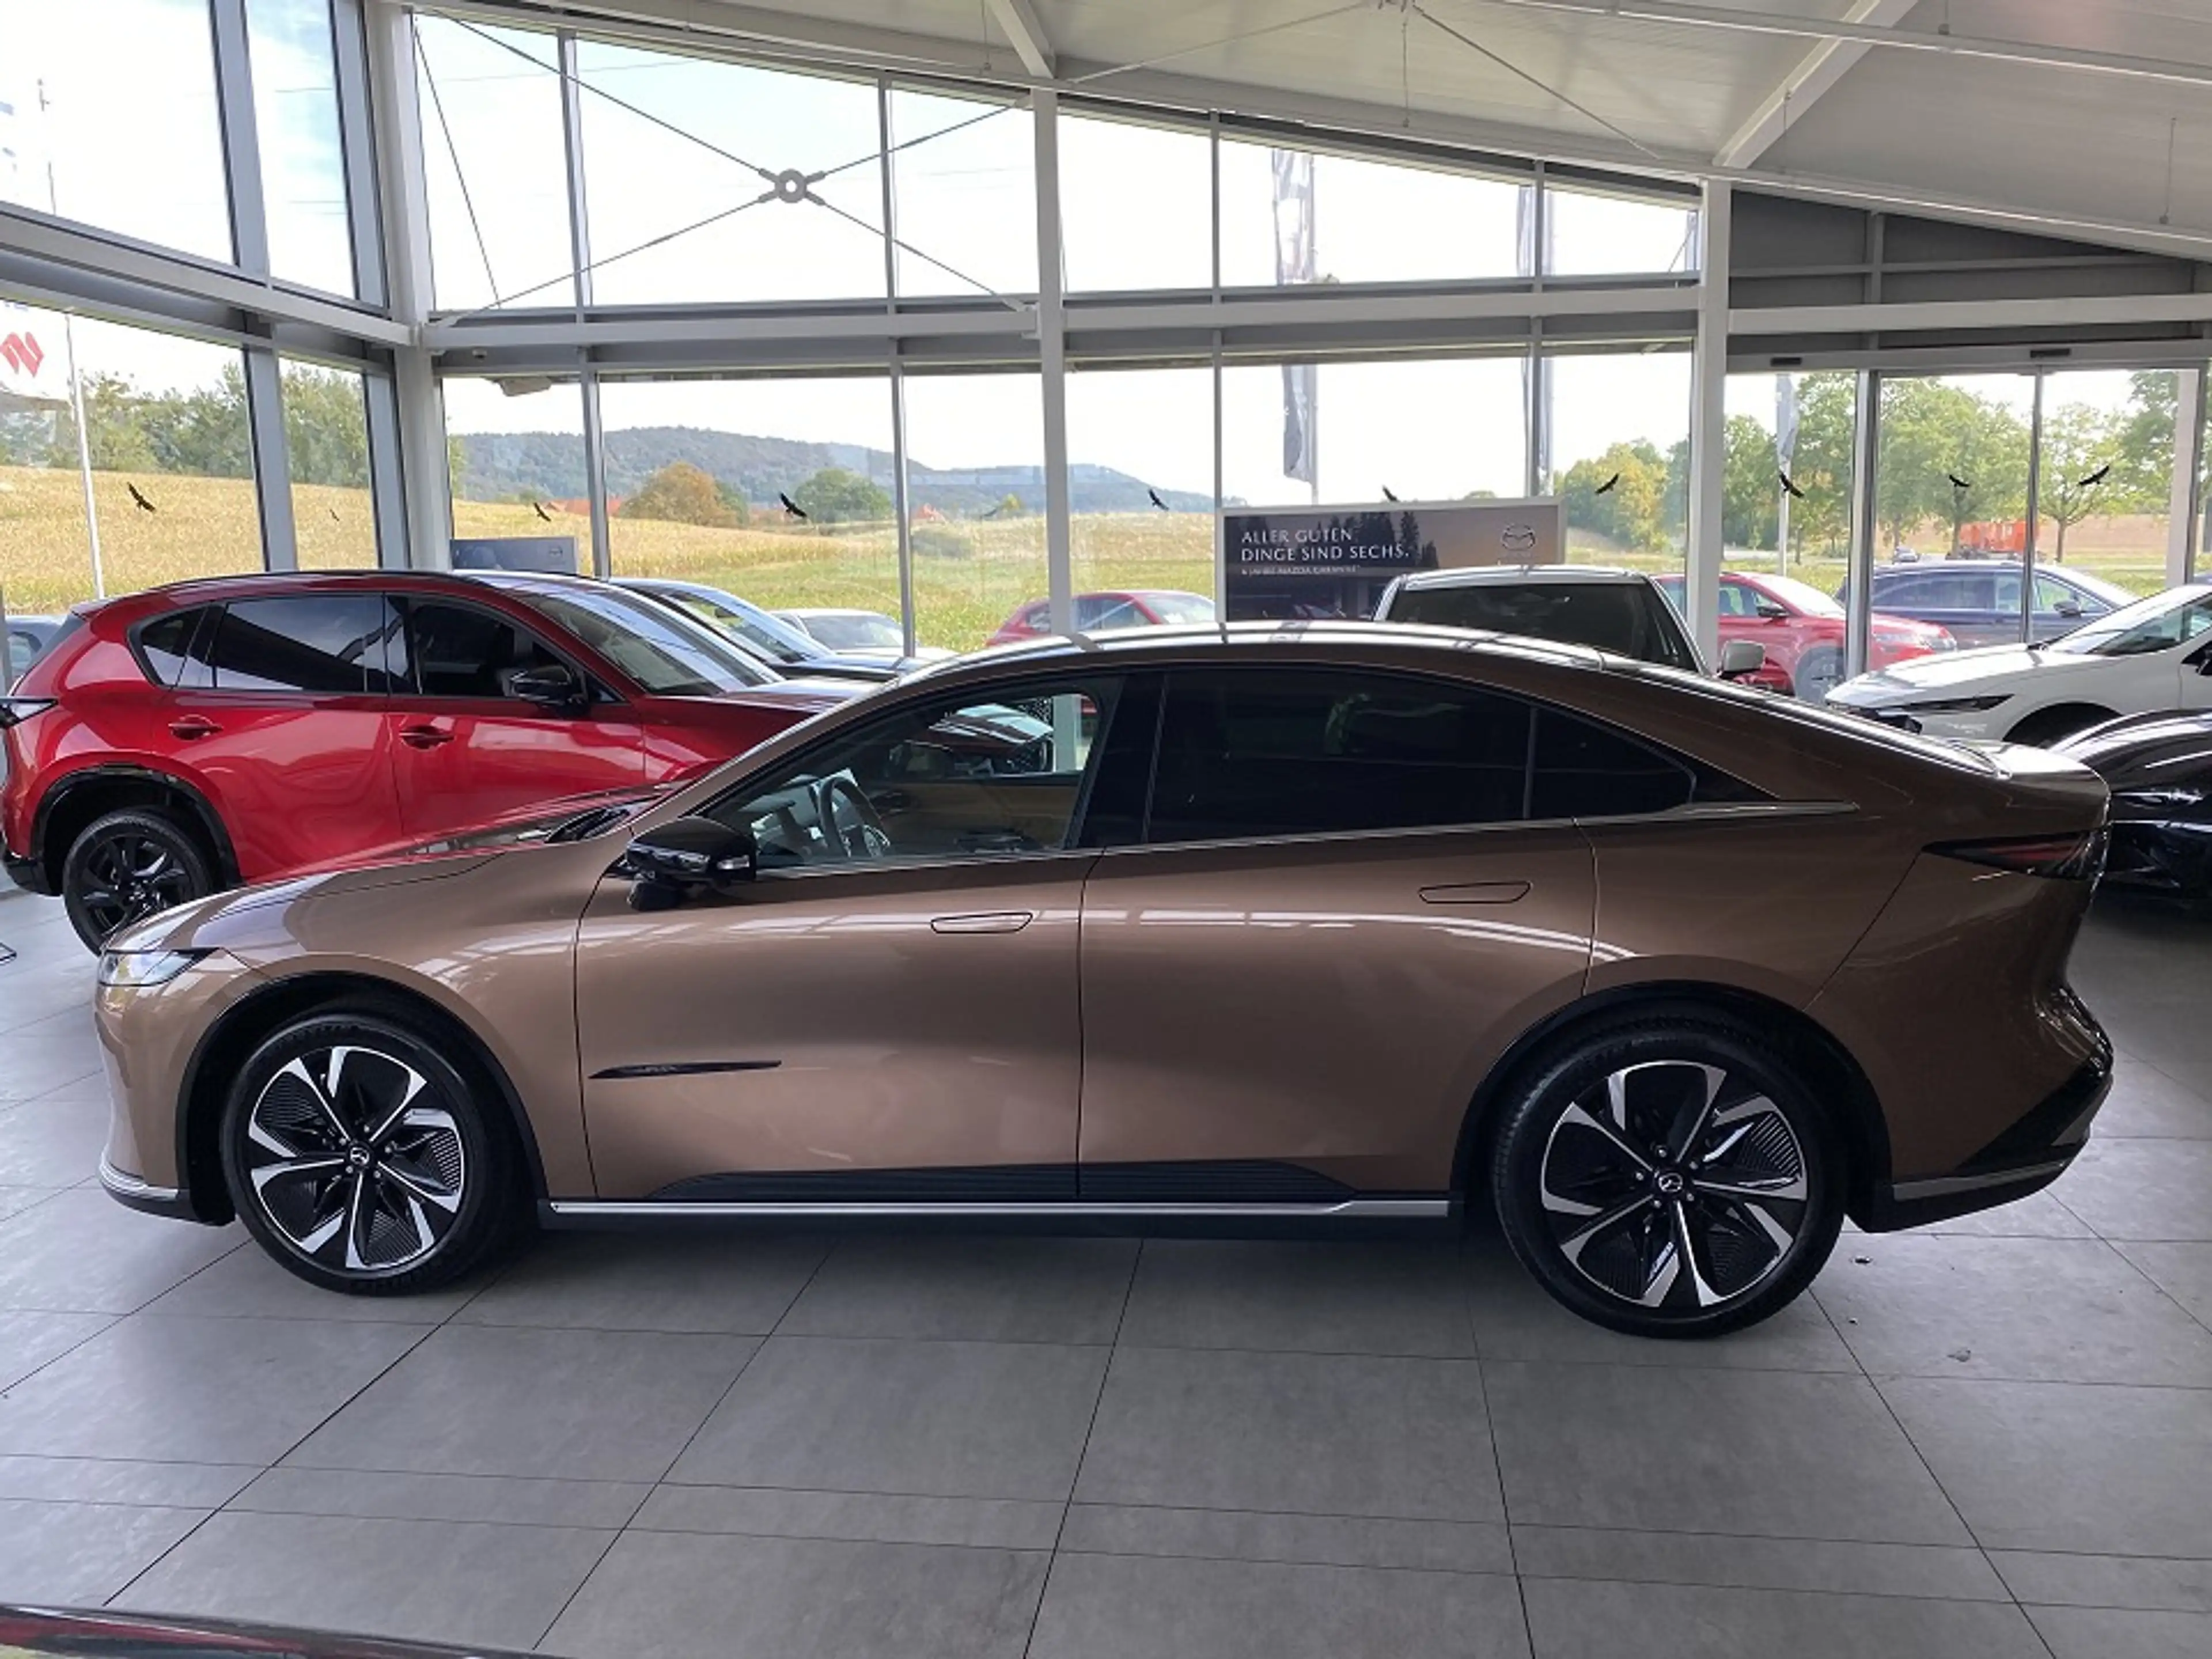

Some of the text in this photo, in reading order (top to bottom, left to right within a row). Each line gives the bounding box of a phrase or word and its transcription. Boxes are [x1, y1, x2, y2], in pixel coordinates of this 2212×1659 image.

[1241, 527, 1352, 544] ALLER GUTEN
[1241, 543, 1410, 562] DINGE SIND SECHS.
